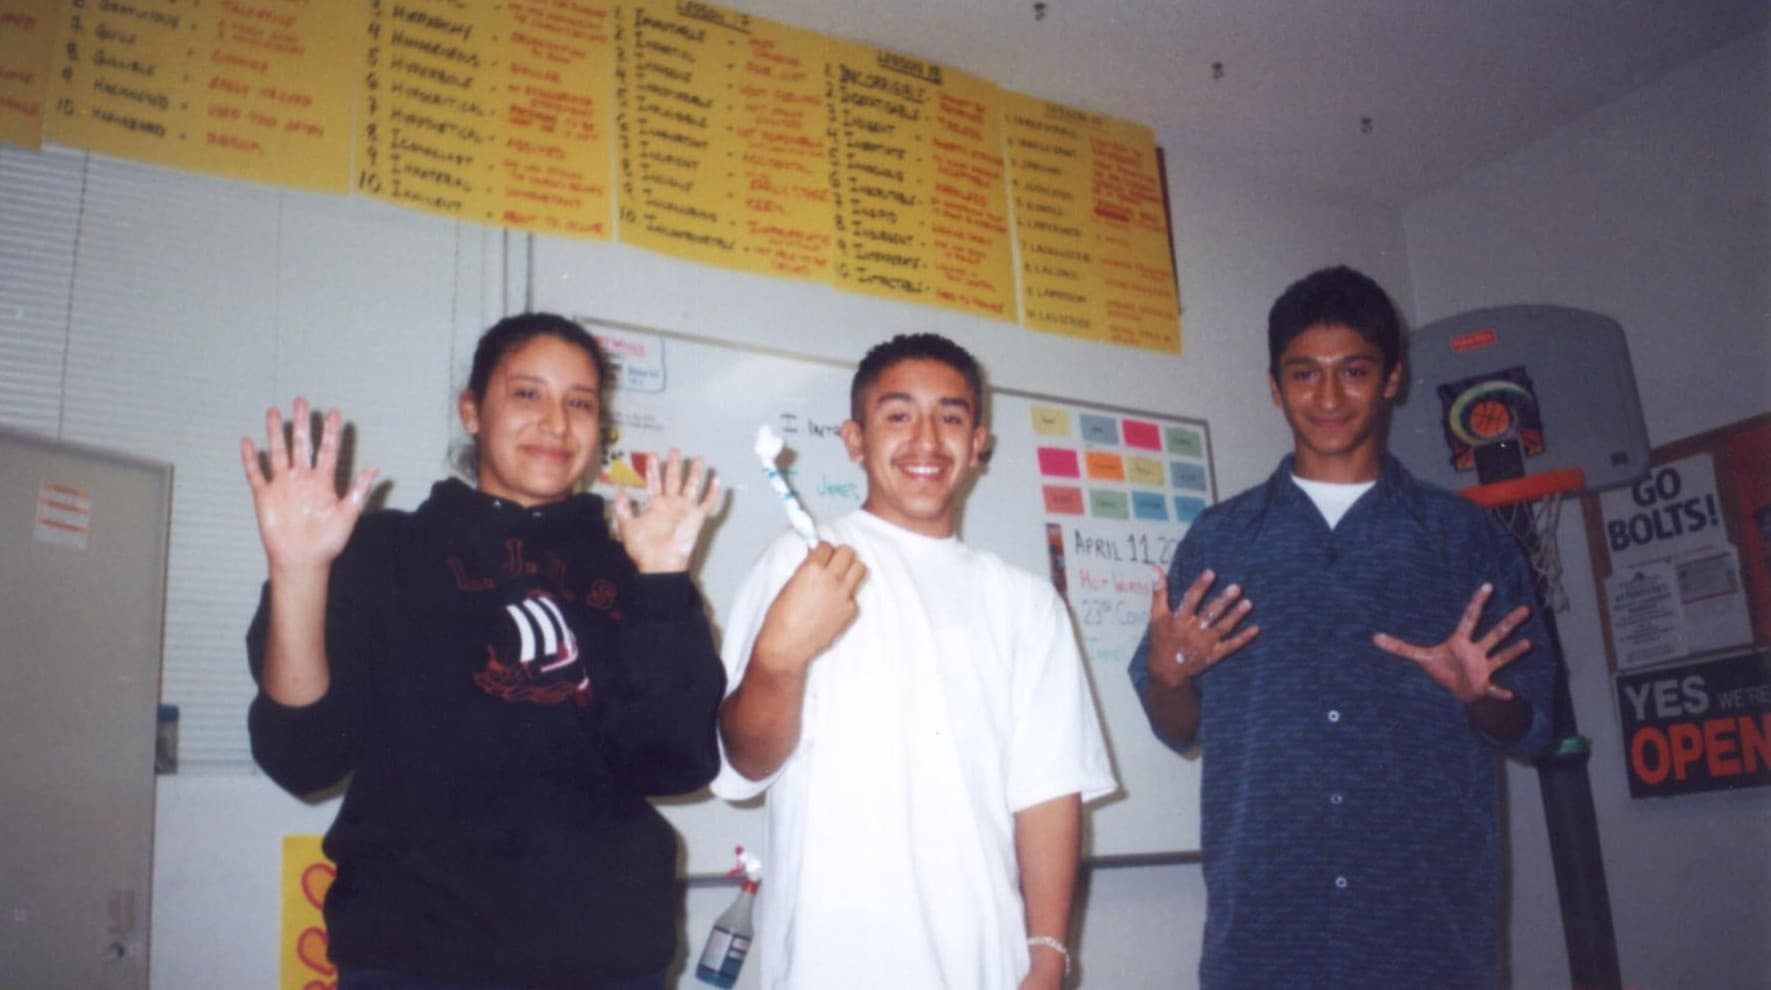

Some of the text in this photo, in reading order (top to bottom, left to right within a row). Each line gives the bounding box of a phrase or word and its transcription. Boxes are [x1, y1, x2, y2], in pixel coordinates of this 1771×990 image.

[1631, 467, 1682, 508] GO
[1074, 528, 1125, 562] APRIL
[1607, 493, 1720, 552] BOLTS!
[1624, 674, 1710, 721] YES
[1631, 711, 1771, 785] OPEN
